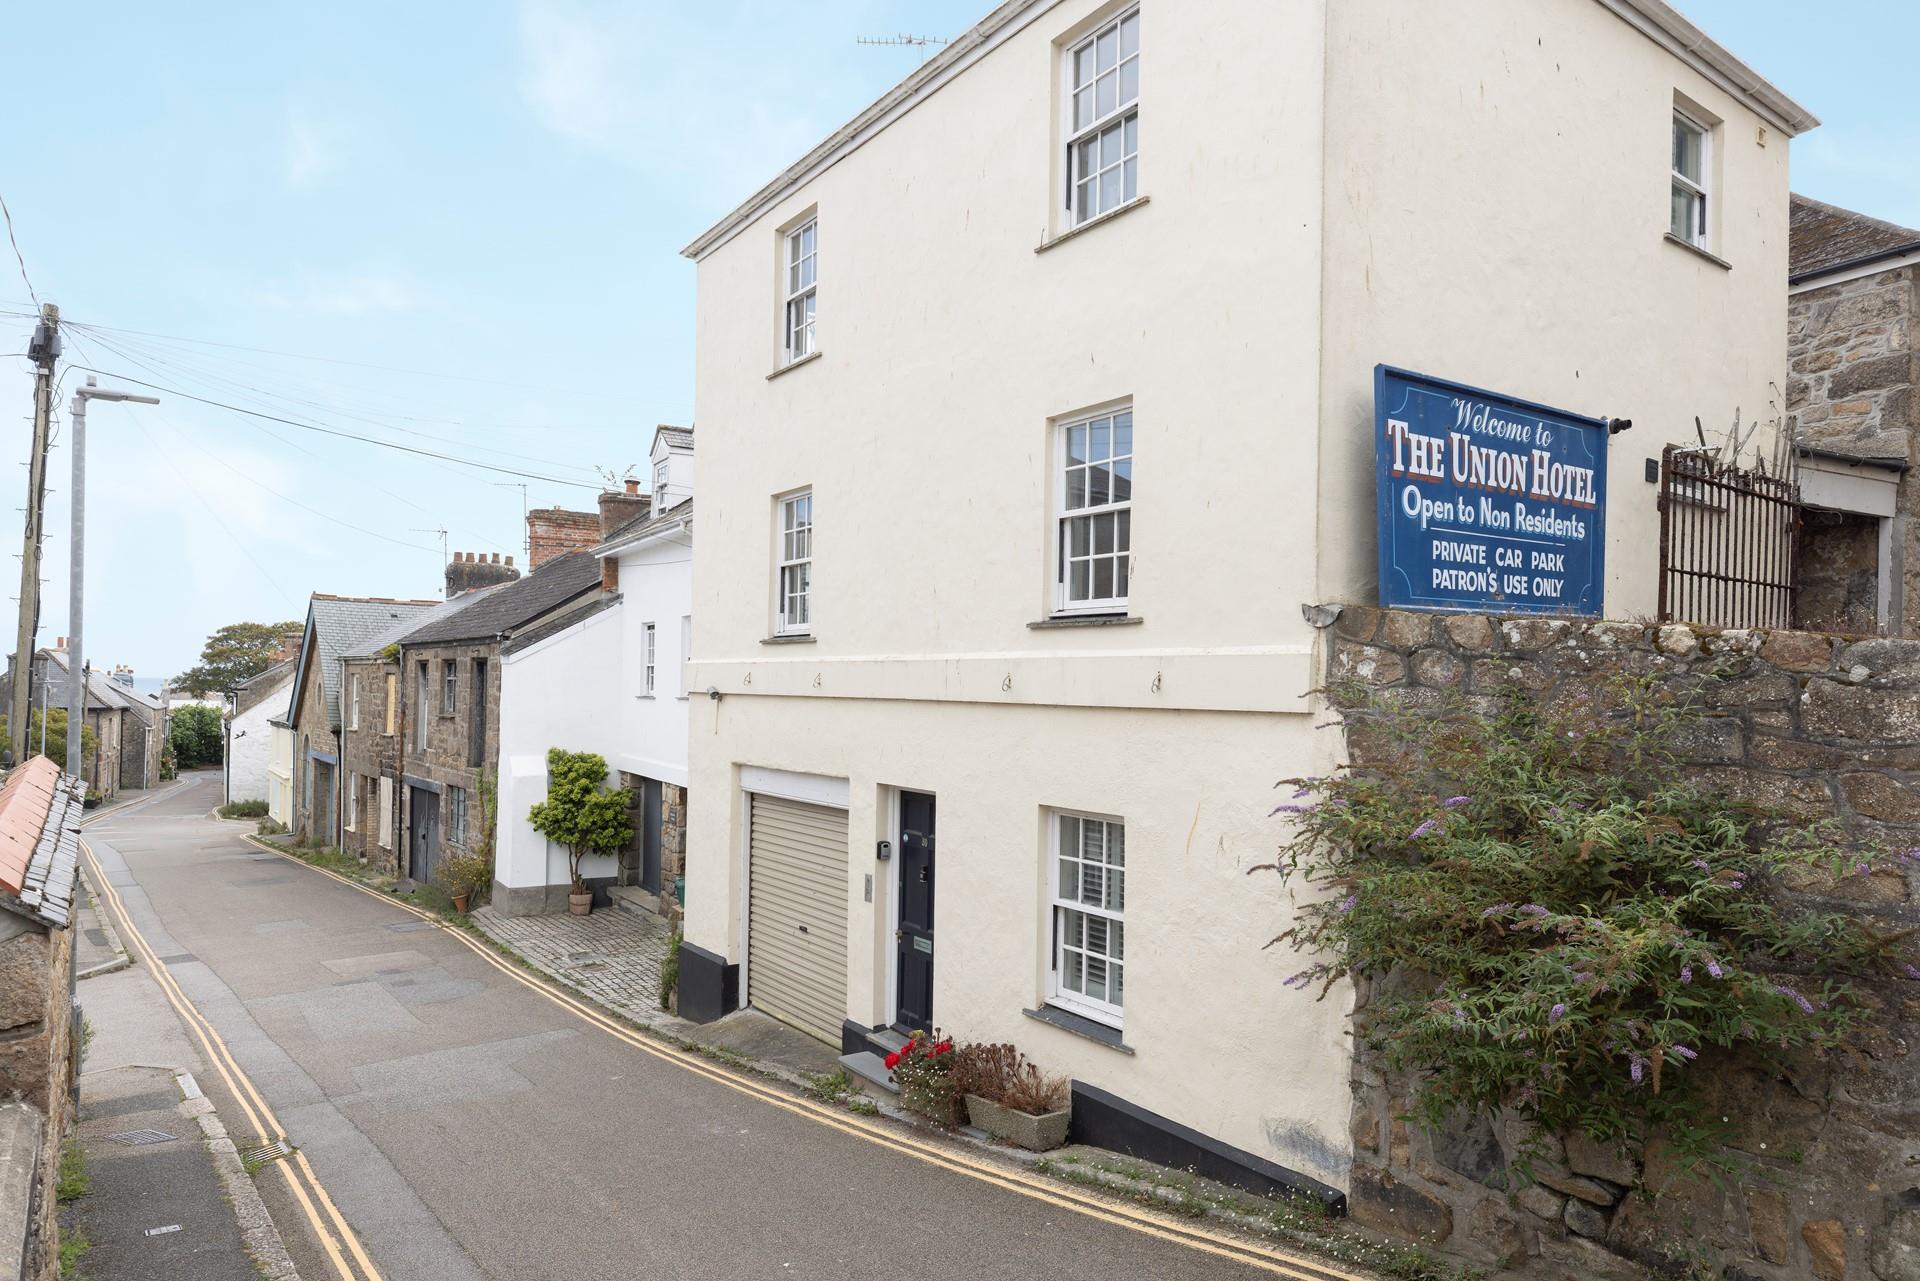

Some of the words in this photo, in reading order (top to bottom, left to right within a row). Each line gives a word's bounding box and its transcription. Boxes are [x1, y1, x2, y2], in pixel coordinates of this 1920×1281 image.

[1451, 398, 1531, 441] Welcome
[1536, 422, 1553, 447] to
[1387, 418, 1445, 479] THE
[1449, 431, 1528, 492] UNION
[1531, 449, 1596, 504] HOTEL
[1403, 484, 1454, 529] Open
[1457, 496, 1474, 522] to
[1480, 496, 1510, 528] Non
[1516, 502, 1586, 539] Residents
[1432, 540, 1486, 564] PRIVATE
[1495, 547, 1522, 568] CAR
[1531, 551, 1564, 572] PARK
[1432, 567, 1497, 593] PATRON'S
[1504, 576, 1528, 595] USE
[1532, 577, 1564, 597] ONLY
